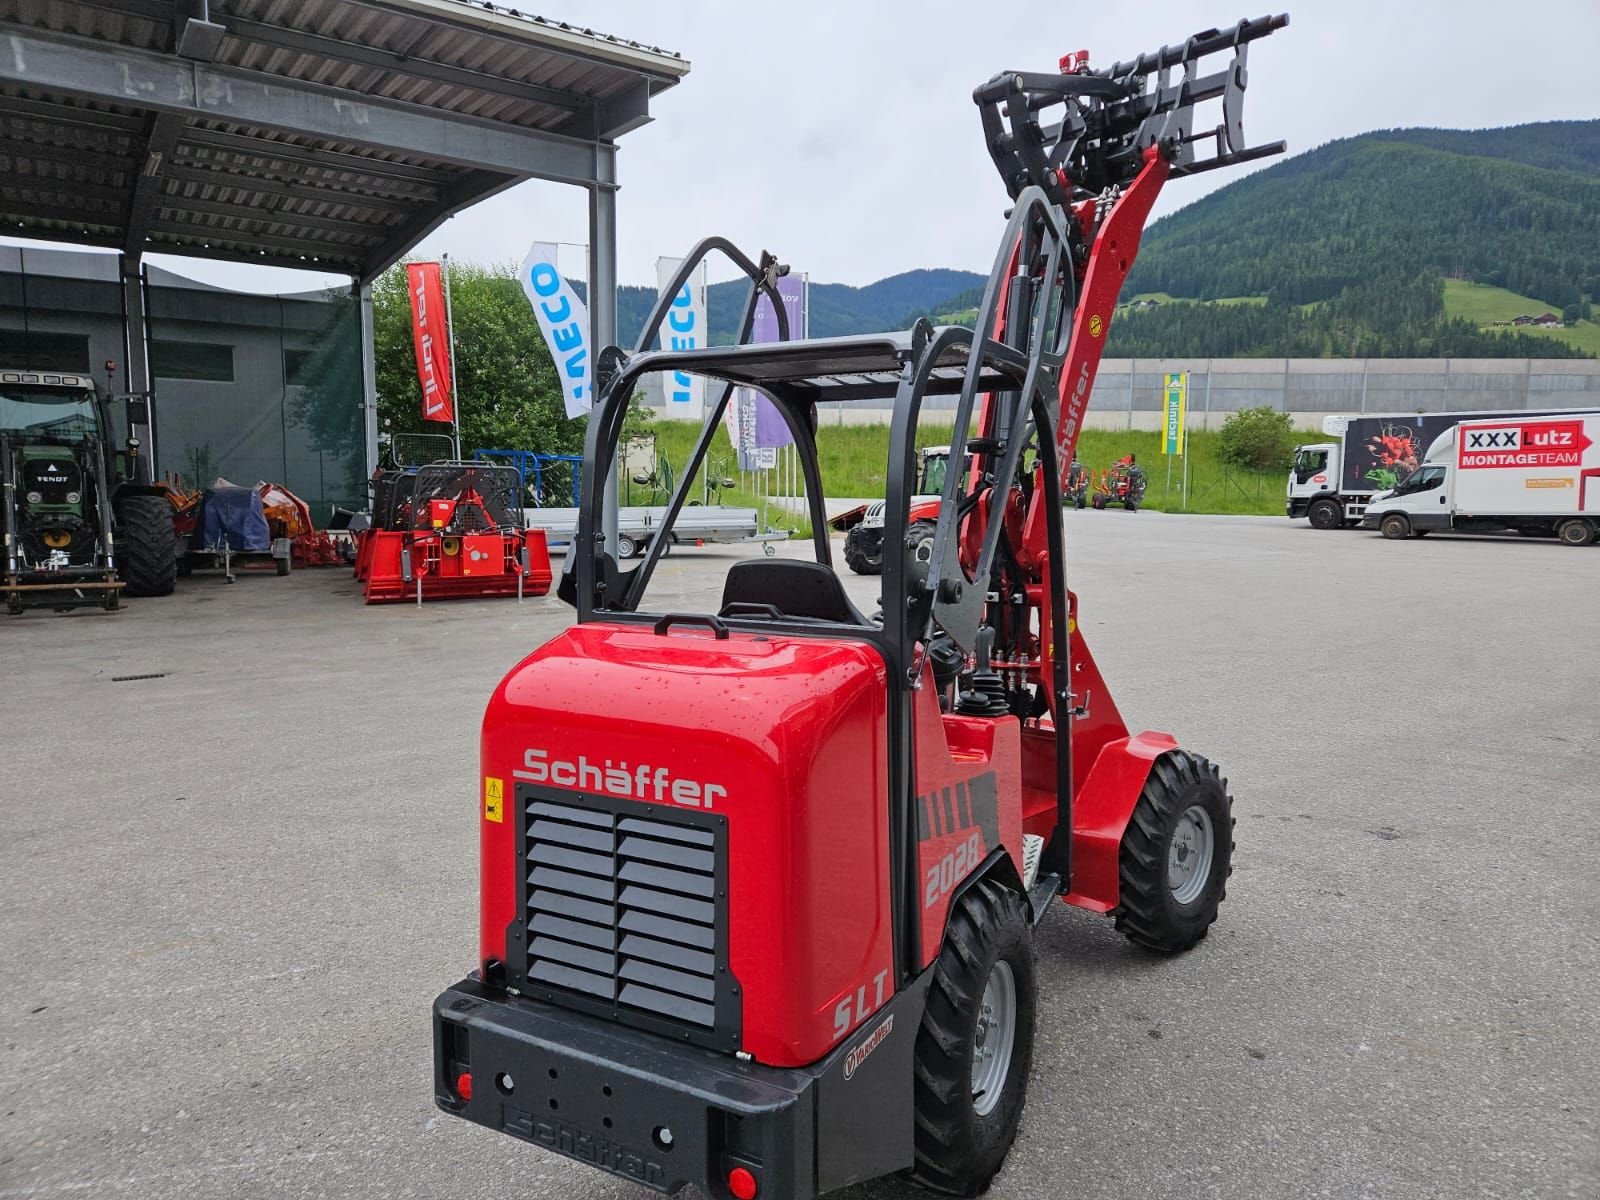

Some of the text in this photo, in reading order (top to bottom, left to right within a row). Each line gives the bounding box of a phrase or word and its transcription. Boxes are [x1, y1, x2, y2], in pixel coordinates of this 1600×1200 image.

[1058, 361, 1089, 476] chäffer
[513, 748, 728, 808] Schäffer
[925, 832, 979, 909] 2028
[833, 968, 888, 1041] SLT
